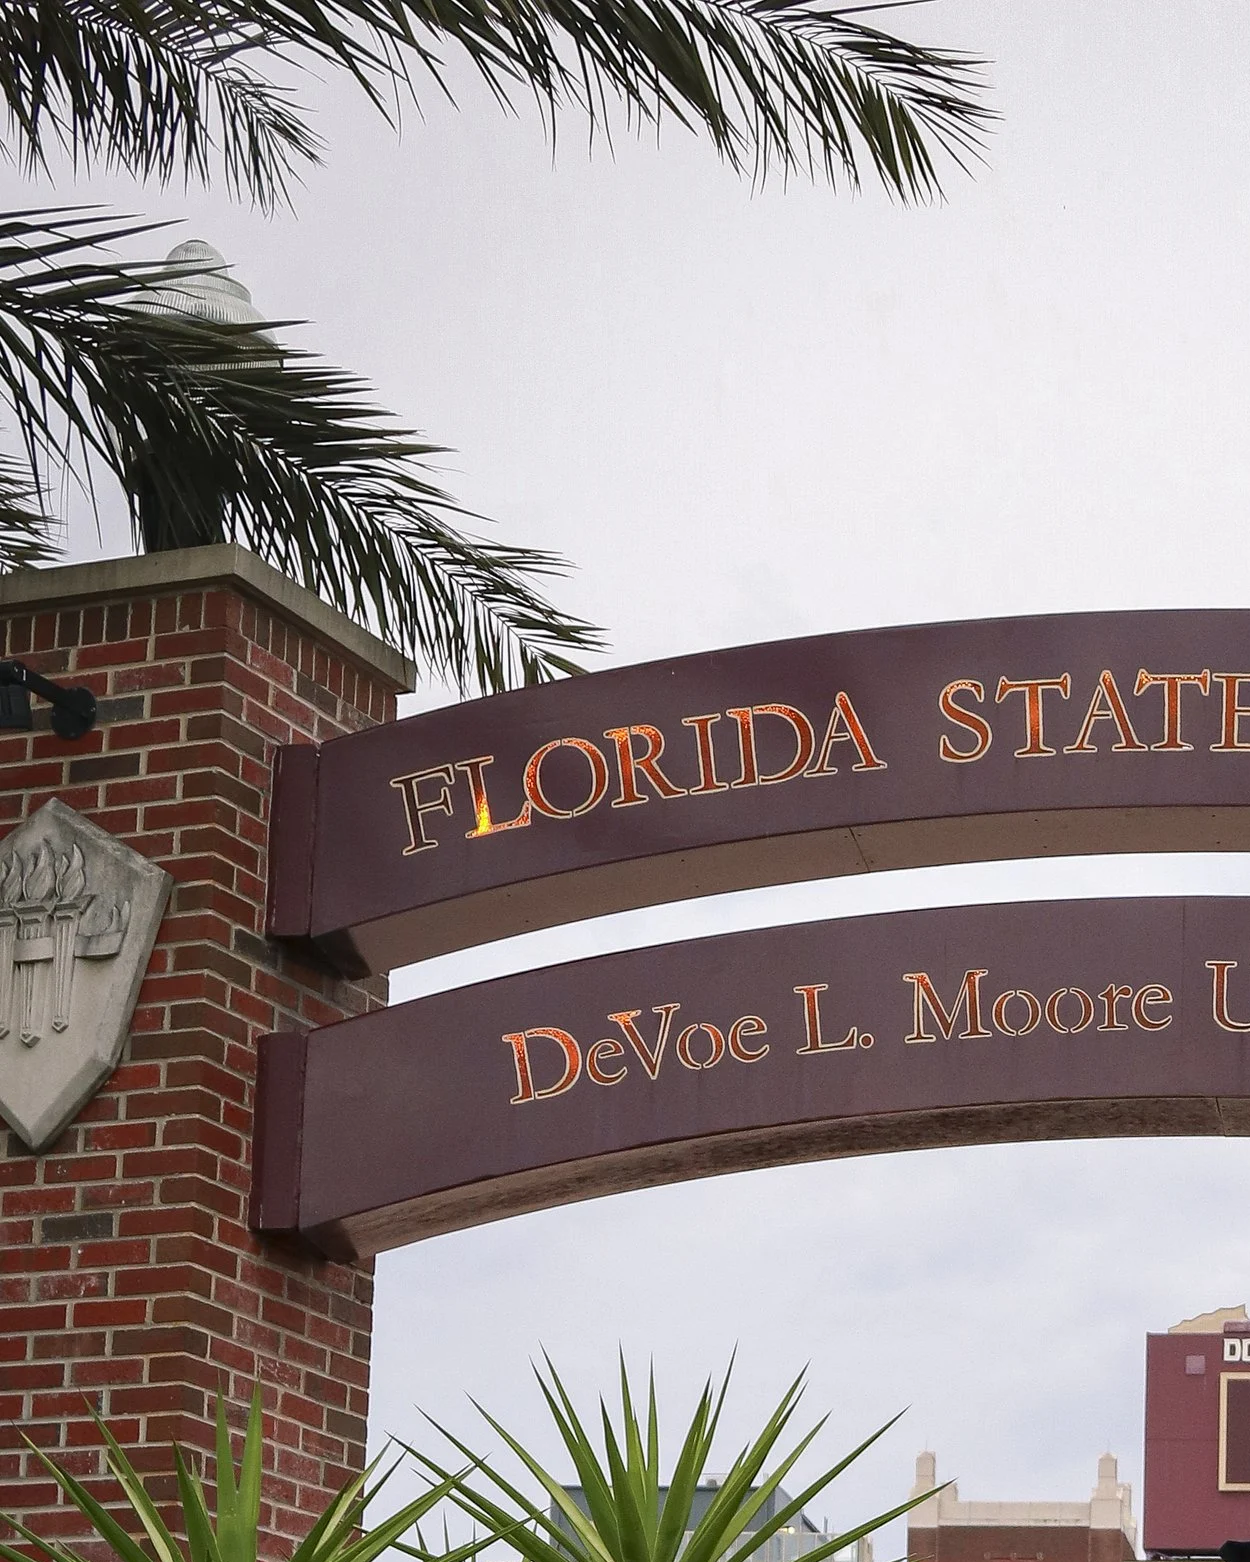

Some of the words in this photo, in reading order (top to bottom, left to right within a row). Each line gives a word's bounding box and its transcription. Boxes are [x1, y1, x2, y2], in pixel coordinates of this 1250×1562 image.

[391, 692, 887, 857] FLORIDA
[501, 1003, 770, 1105] DeVoe
[794, 983, 874, 1056] L.
[902, 969, 1174, 1045] Moore
